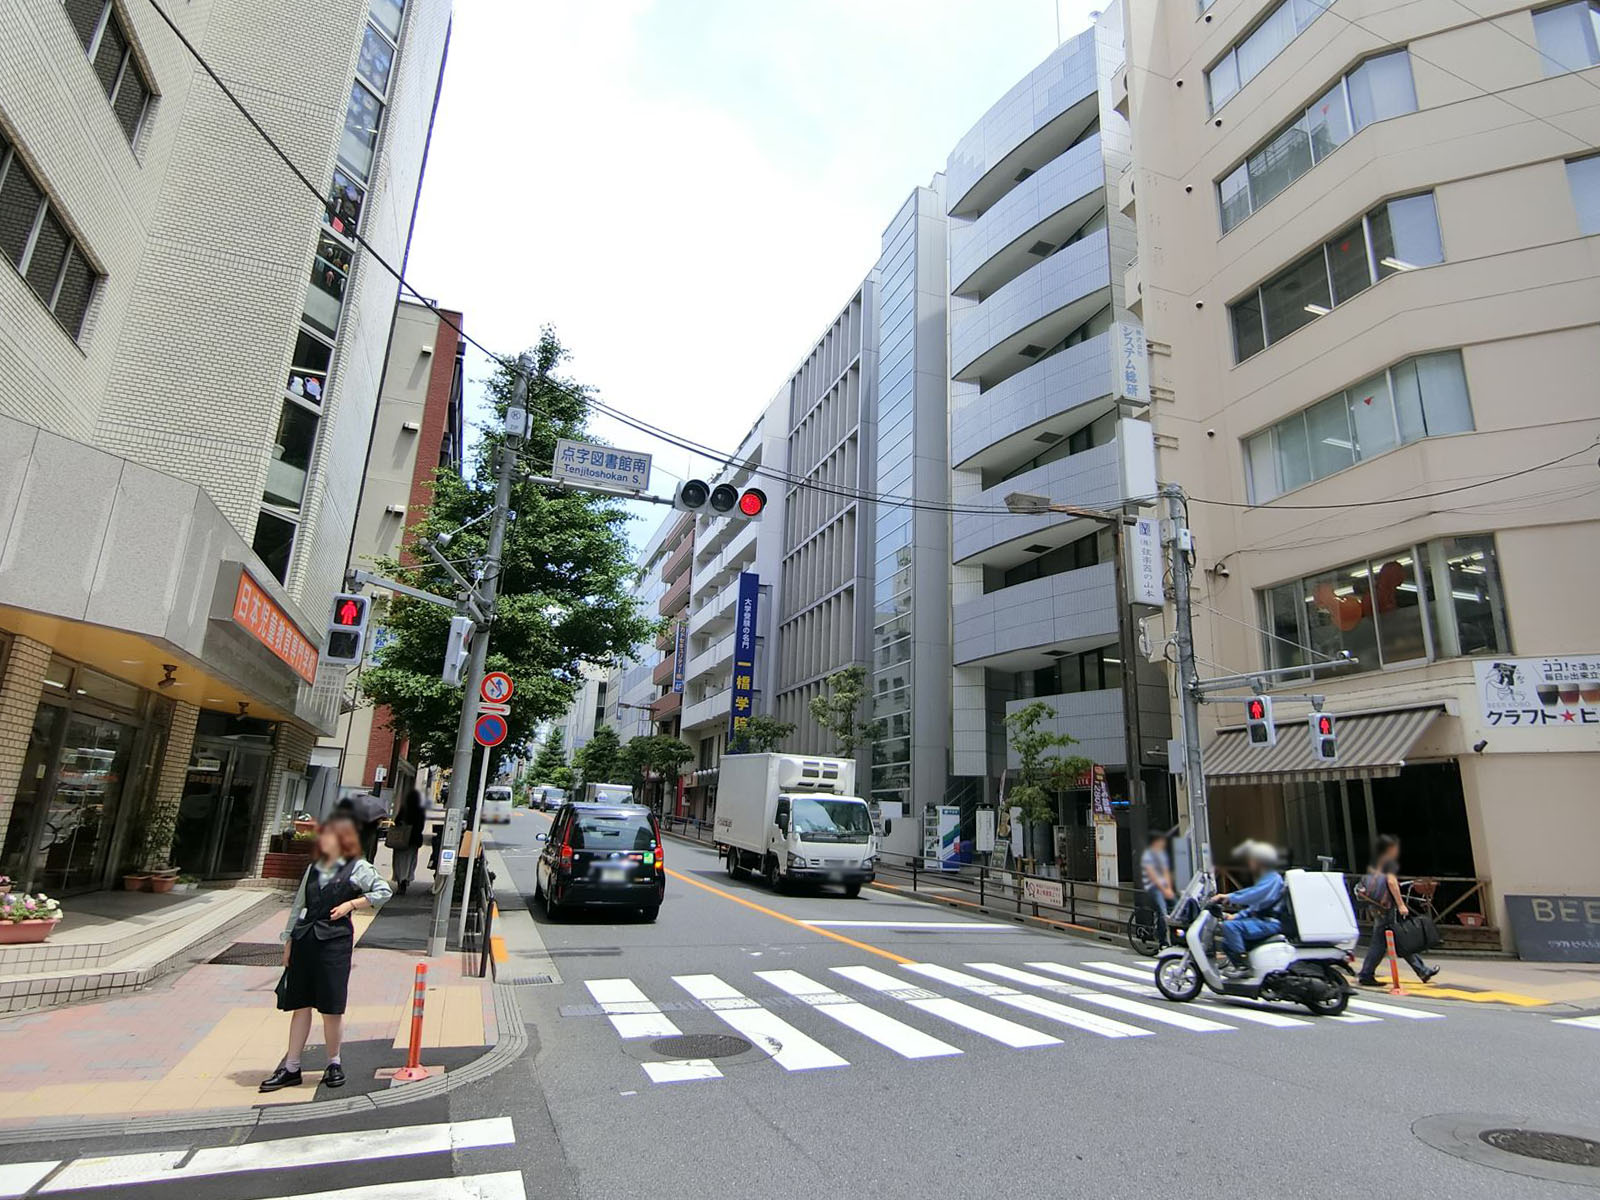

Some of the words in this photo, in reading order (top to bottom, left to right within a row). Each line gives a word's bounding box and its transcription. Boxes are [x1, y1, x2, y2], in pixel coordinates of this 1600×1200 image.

[1123, 325, 1138, 397] システム総研
[561, 446, 648, 474] 点字図書館南
[563, 463, 628, 482] Tenjitoshokan
[632, 475, 641, 485] S.
[238, 583, 316, 681] 日本児童教育専門学校
[741, 598, 752, 648] 大学受験の名門
[734, 661, 752, 732] 一橋学院
